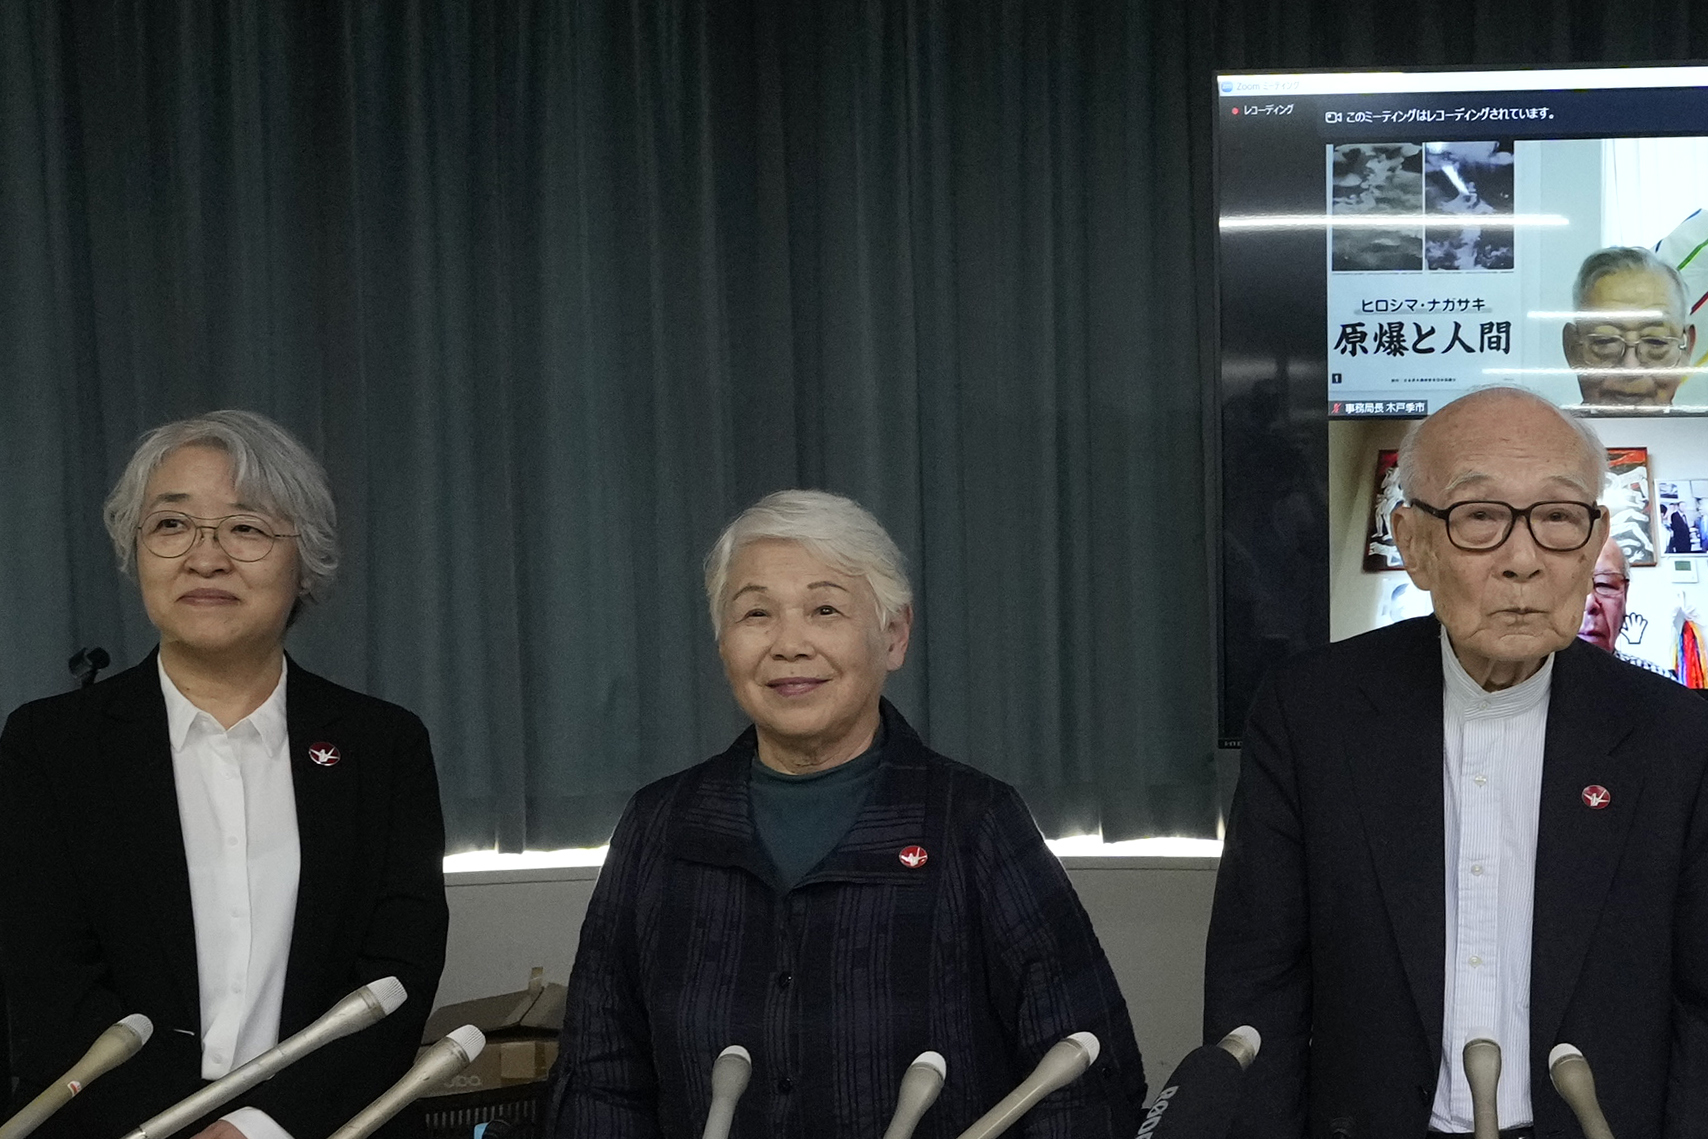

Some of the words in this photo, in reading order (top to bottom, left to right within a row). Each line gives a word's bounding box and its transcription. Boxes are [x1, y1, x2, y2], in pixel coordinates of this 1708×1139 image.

[1236, 82, 1260, 91] Zoom
[1243, 103, 1295, 116] レコーディング
[1345, 106, 1555, 124] このミーティングはレコーディングされています。
[1361, 297, 1486, 313] ヒロシマ・ナガサキ
[1333, 320, 1512, 358] 原爆と人間
